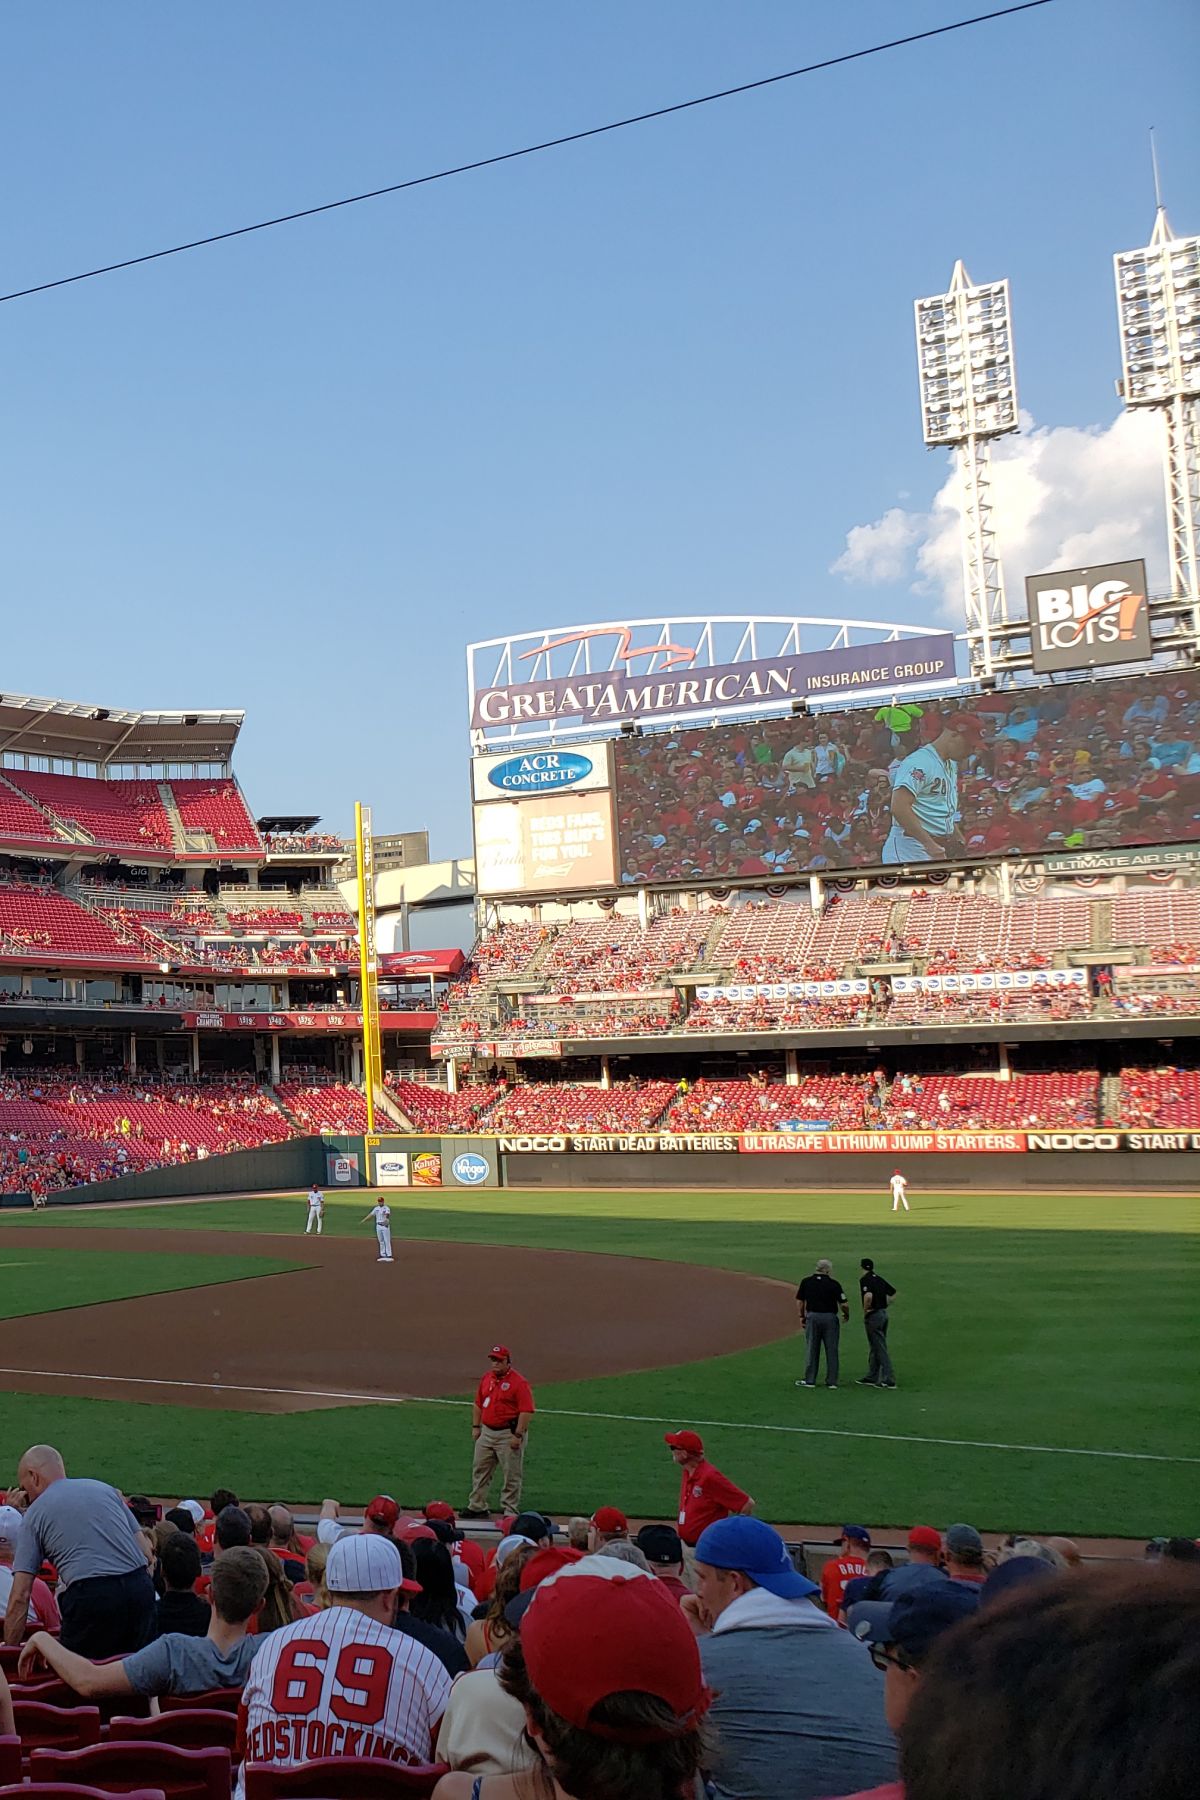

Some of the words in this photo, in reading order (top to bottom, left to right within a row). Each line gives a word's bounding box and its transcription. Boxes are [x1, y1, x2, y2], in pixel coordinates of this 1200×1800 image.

[1037, 580, 1133, 623] BIG
[479, 683, 601, 723] GREAT
[807, 668, 889, 690] INSURANCE
[894, 660, 944, 679] GROUP
[519, 754, 560, 772] ACR
[502, 768, 576, 787] CONCRETE
[529, 815, 564, 831] REDS
[531, 831, 561, 846] THIS
[531, 846, 558, 862] FOR
[560, 843, 592, 860] YOU.
[1049, 856, 1130, 871] ULTIMATE
[1131, 854, 1159, 865] AIR
[499, 1137, 565, 1151] NOCO
[573, 1137, 614, 1151] START
[619, 1136, 655, 1151] DEAD
[659, 1136, 737, 1151] BATTERIES.
[744, 1135, 824, 1150] ULTRASAFE
[828, 1135, 888, 1150] LITHIUM
[891, 1135, 933, 1150] JUMP
[937, 1134, 1020, 1149] STARTERS.
[1027, 1134, 1119, 1150] NOCO
[1128, 1133, 1188, 1150] START
[337, 1162, 348, 1170] 20
[413, 1157, 441, 1171] Kahn's
[457, 1159, 486, 1180] Kroger
[270, 1638, 394, 1726] 69
